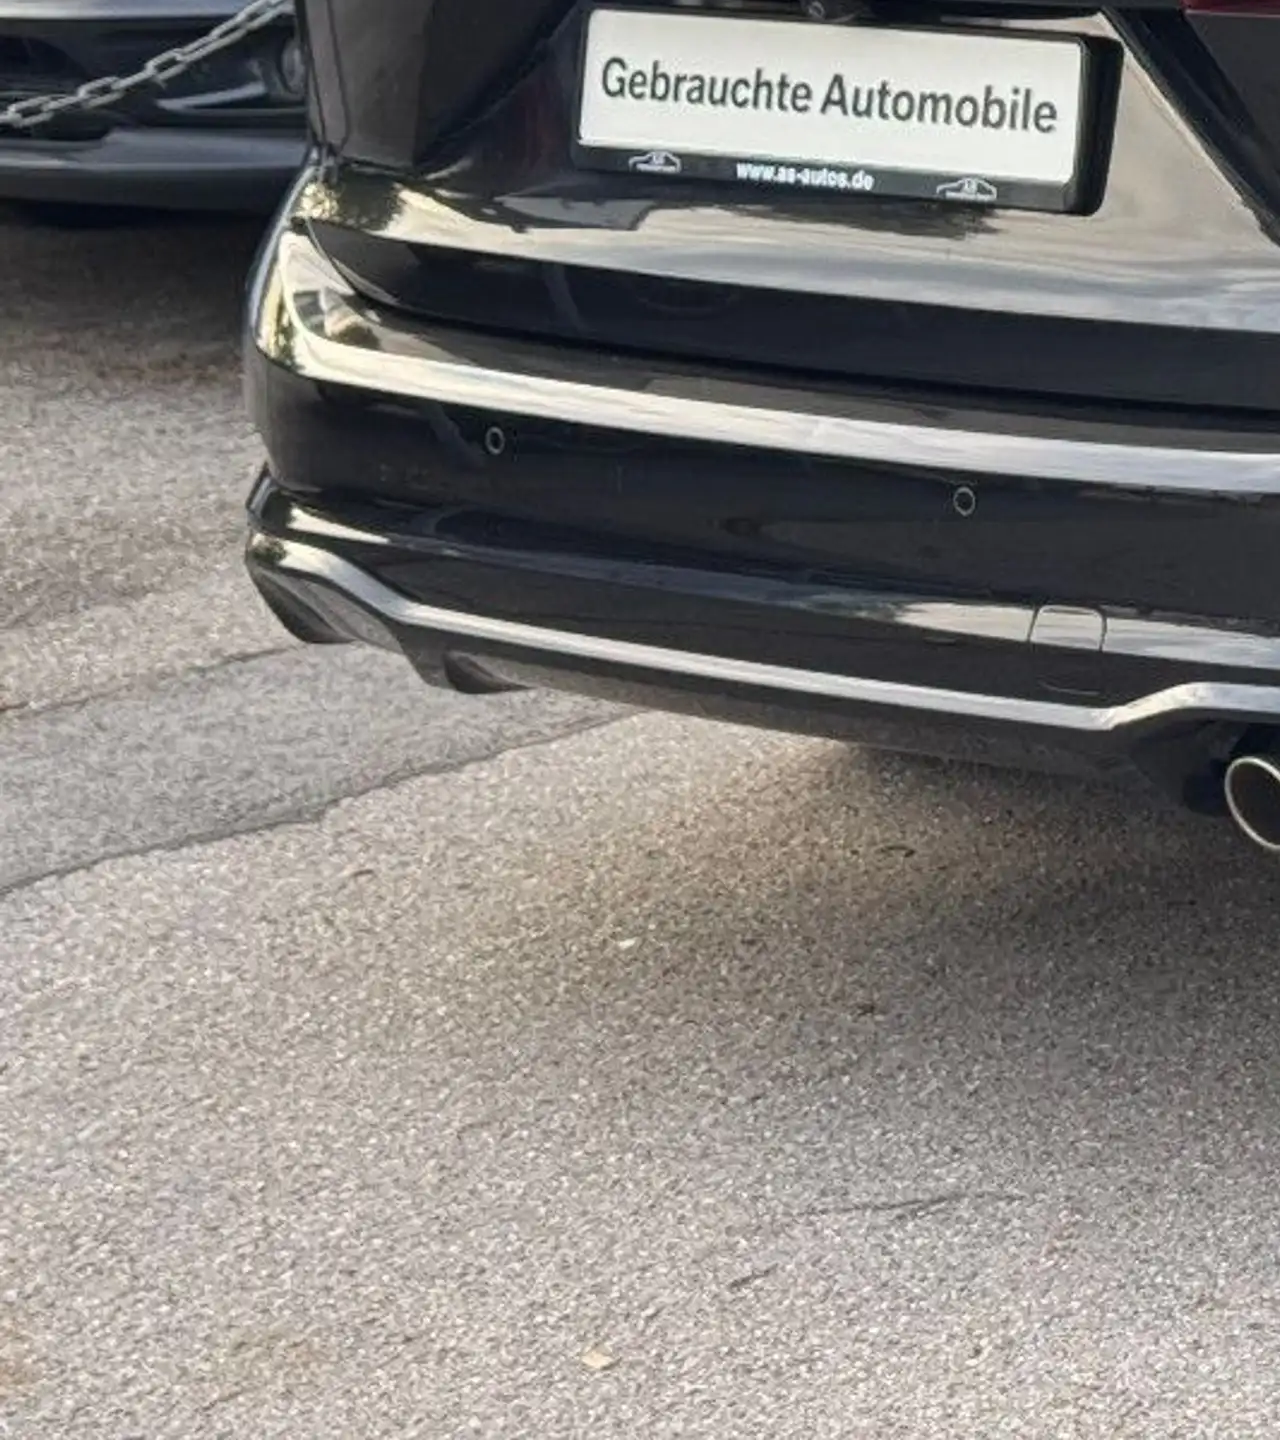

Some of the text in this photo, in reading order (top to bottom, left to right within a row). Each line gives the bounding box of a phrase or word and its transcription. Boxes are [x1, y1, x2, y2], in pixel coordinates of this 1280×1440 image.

[600, 55, 1058, 134] Gebrauchte Automobile
[735, 162, 875, 192] www.as-autos.de
